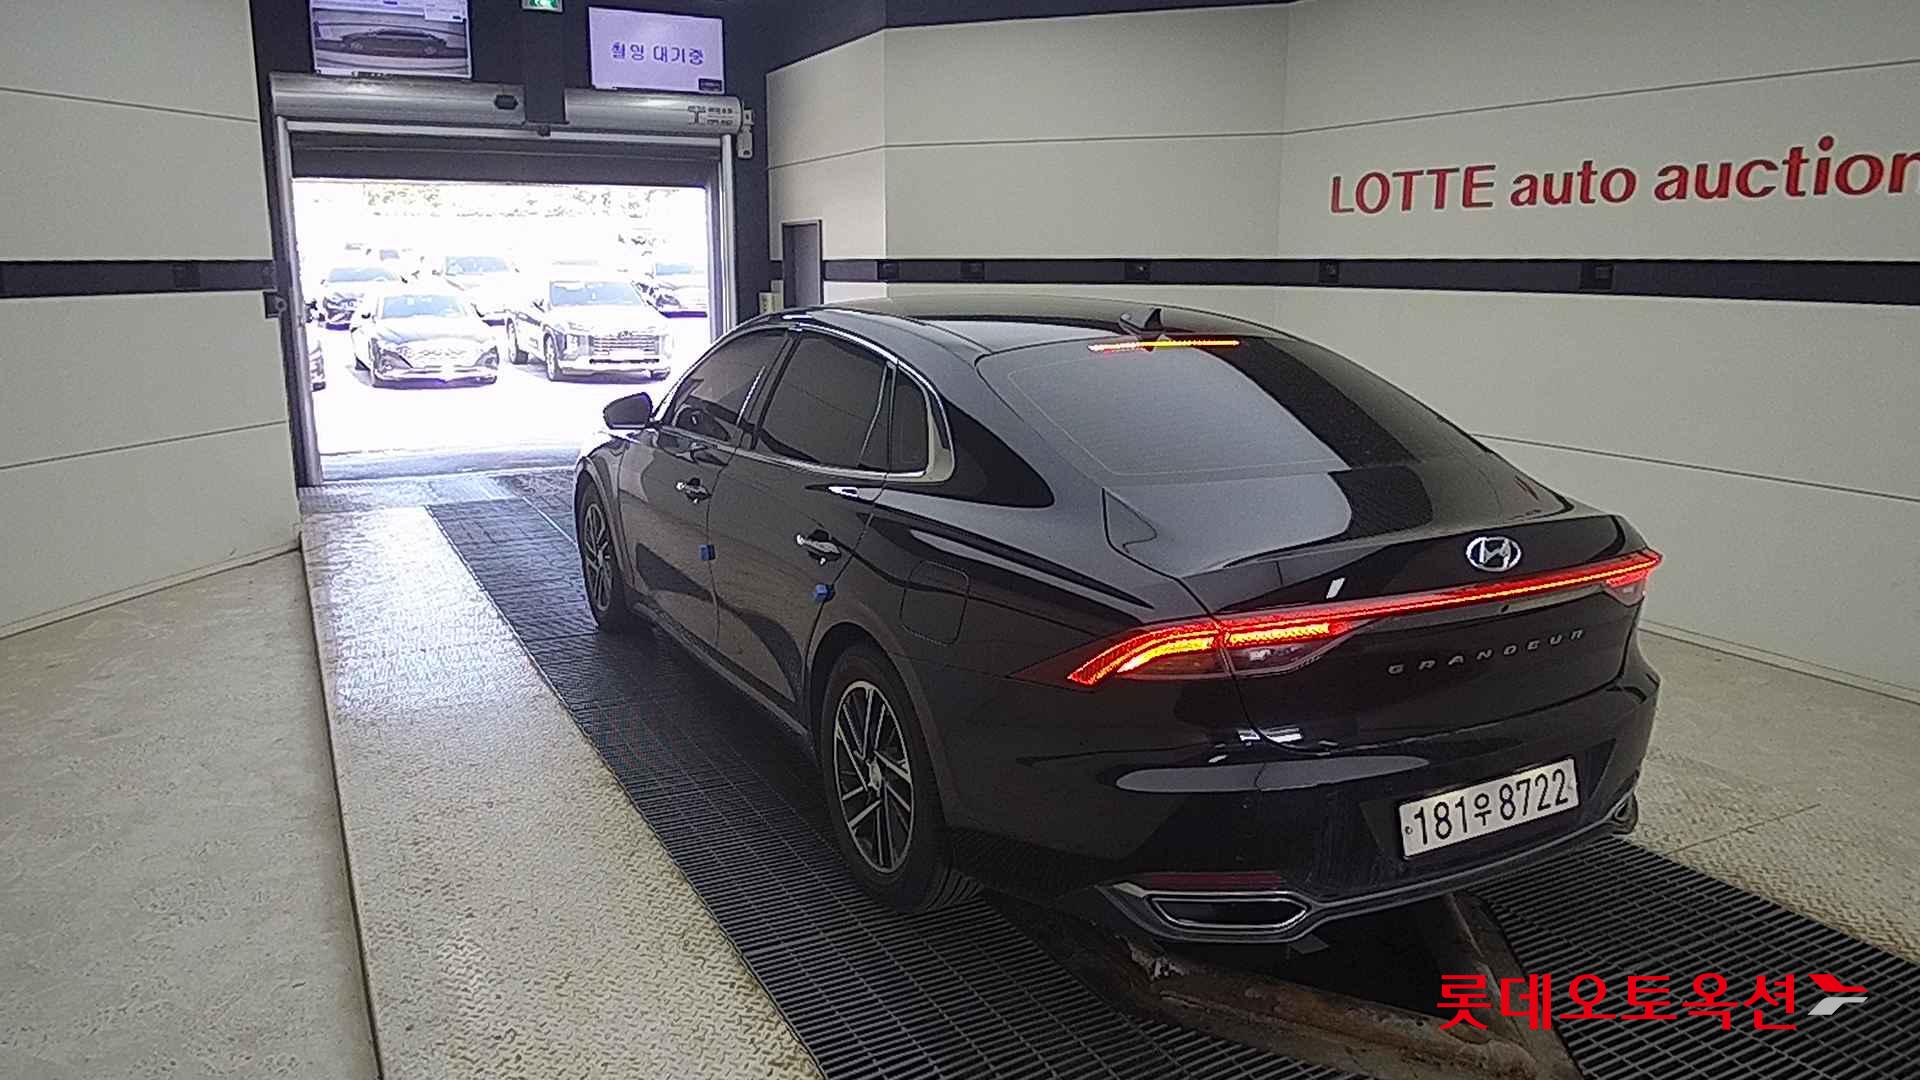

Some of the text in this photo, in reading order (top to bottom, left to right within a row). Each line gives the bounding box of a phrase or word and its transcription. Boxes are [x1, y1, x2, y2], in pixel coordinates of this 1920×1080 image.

[652, 46, 705, 66] 대기중
[1330, 135, 1920, 214] LOTTE auto auction
[1388, 629, 1584, 675] GRANDEUR
[1414, 768, 1569, 846] 181우8722
